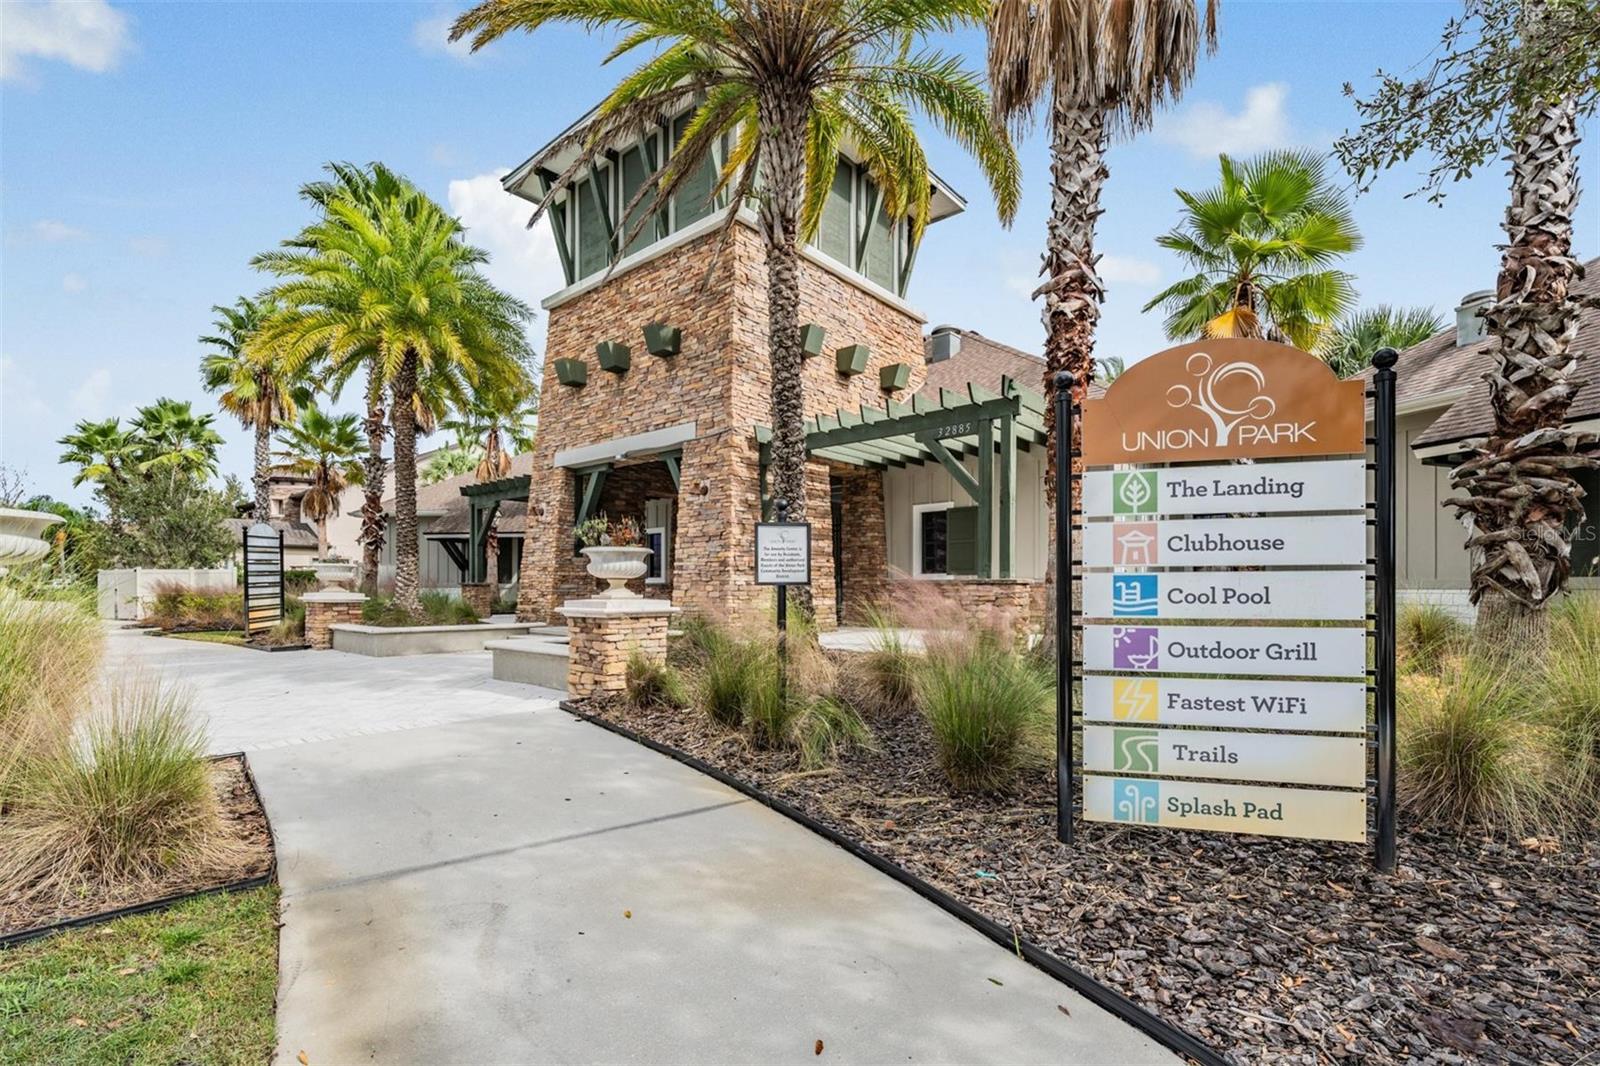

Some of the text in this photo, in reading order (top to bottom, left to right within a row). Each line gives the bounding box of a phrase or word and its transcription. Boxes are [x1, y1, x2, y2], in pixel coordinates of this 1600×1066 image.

[938, 422, 971, 438] 32885
[1122, 421, 1317, 451] UNION PARK
[1167, 476, 1305, 498] The Landing
[1167, 534, 1285, 552] Clubhouse
[1167, 586, 1271, 605] Cool Pool
[1167, 641, 1318, 661] Outdoor Grill
[1167, 693, 1308, 714] Fastest WiFi
[1173, 744, 1239, 764] Trails
[1167, 796, 1283, 821] Splash Pad
